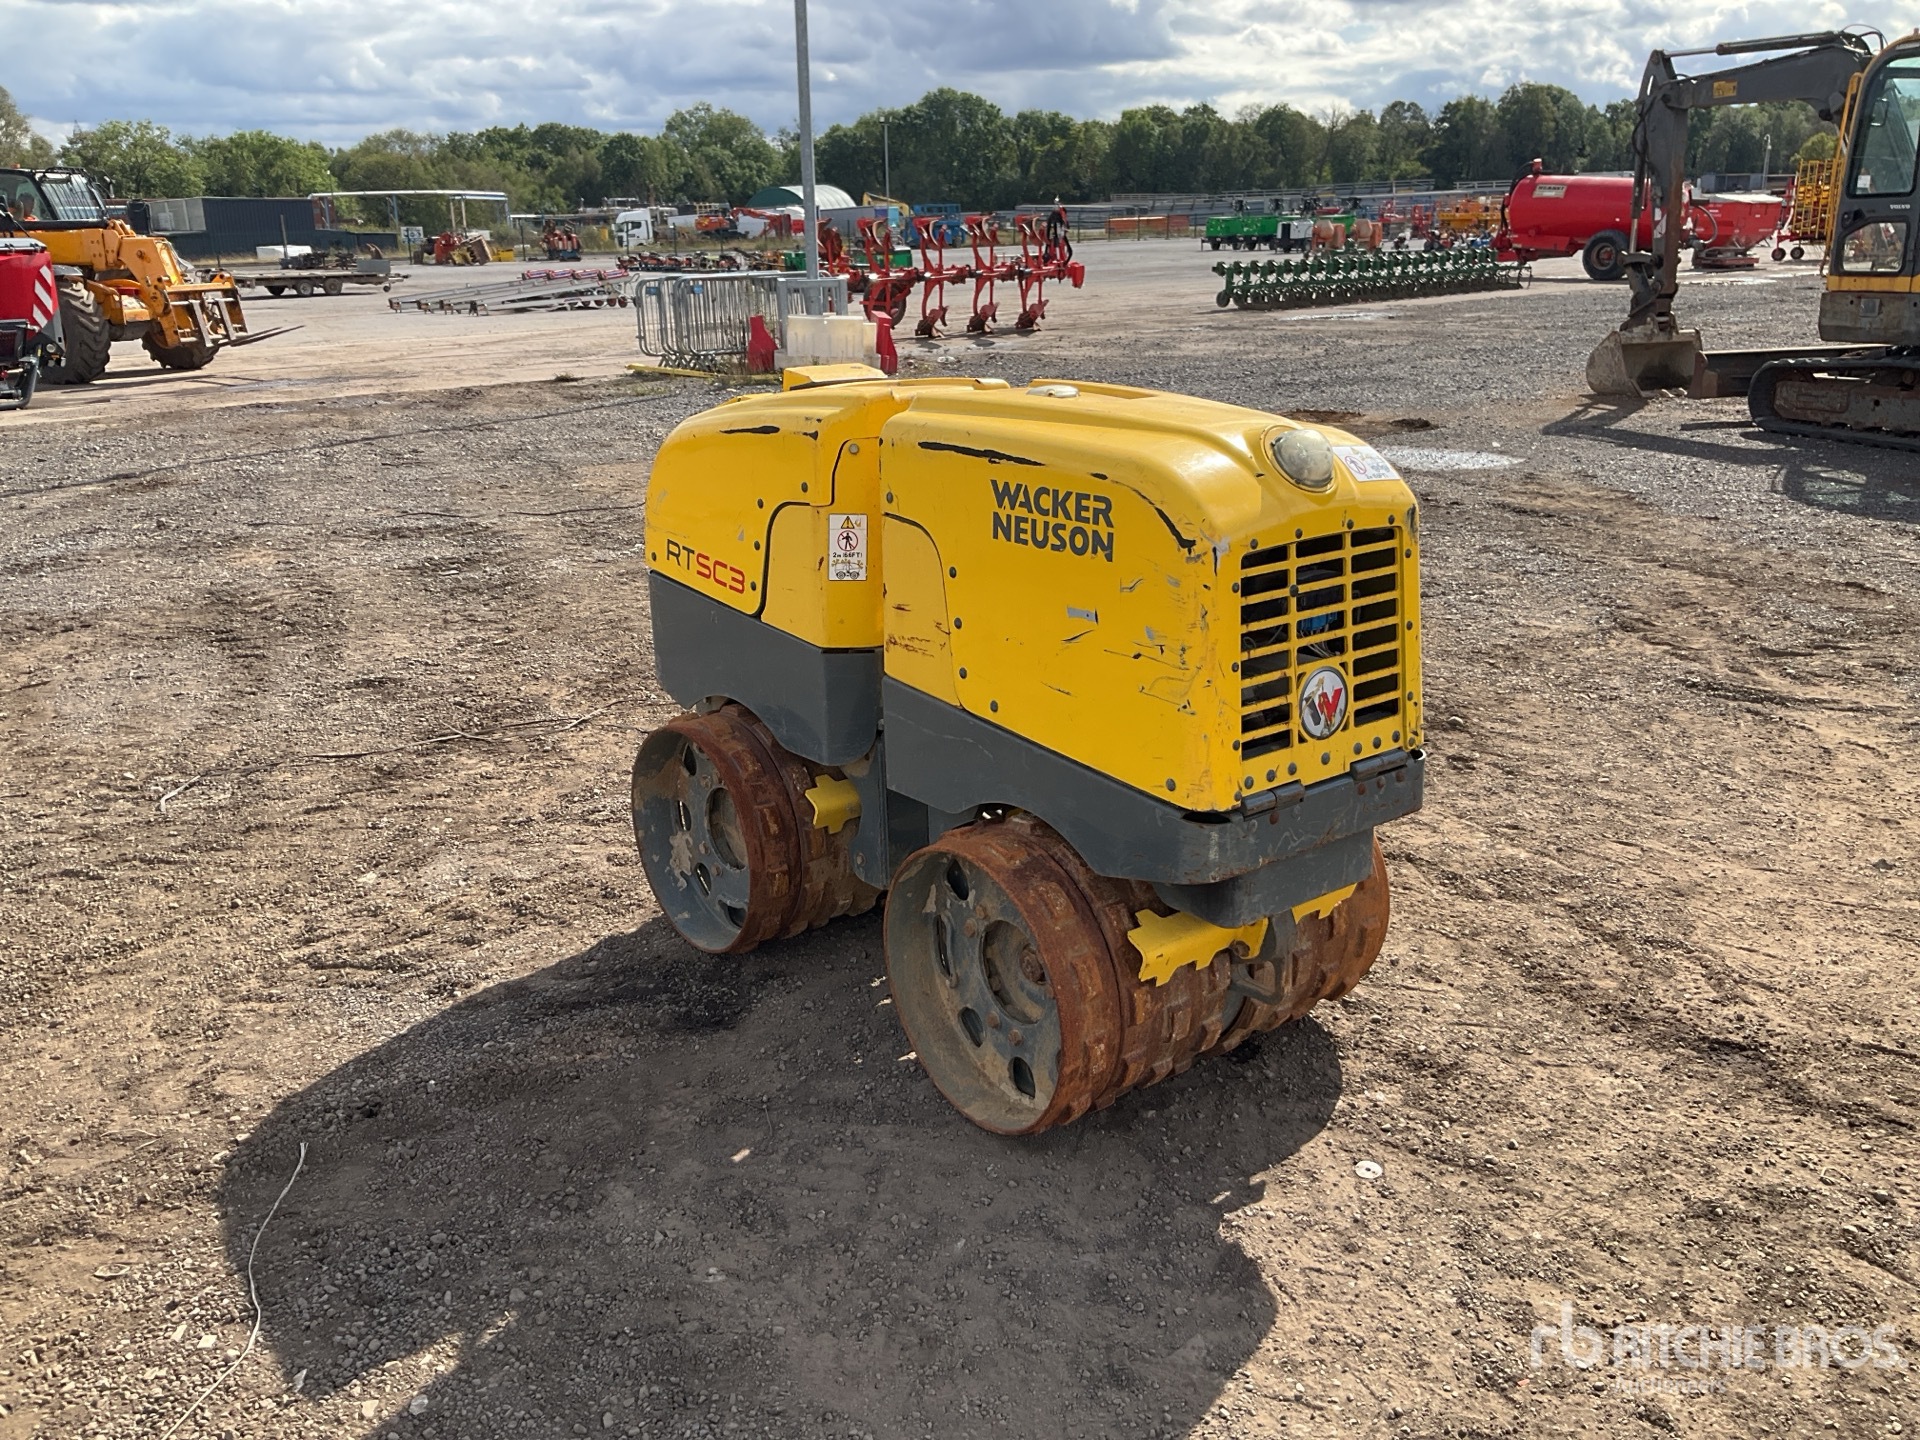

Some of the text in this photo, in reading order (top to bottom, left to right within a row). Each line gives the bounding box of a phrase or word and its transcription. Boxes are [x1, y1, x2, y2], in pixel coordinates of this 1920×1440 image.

[990, 479, 1114, 528] WACKER
[992, 511, 1114, 562] NEUSON
[666, 538, 745, 594] RTSC3
